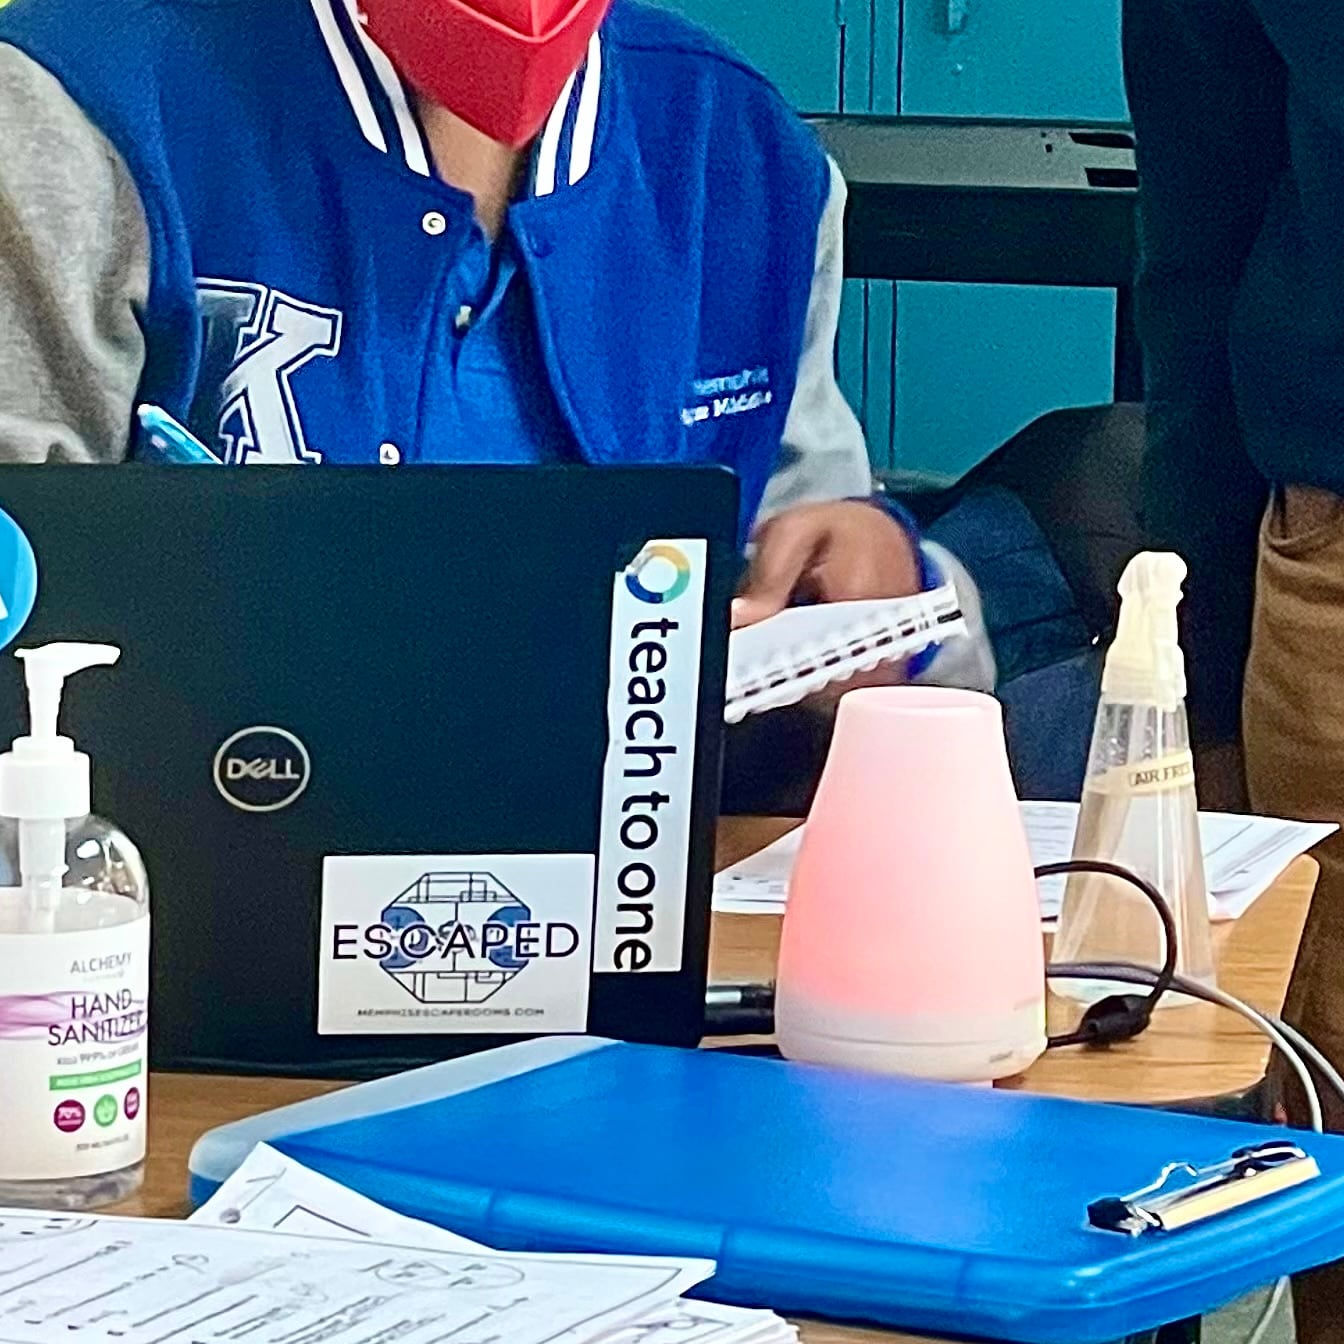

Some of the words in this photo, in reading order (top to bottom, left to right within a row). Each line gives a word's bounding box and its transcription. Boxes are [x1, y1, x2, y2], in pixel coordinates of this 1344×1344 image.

[186, 276, 343, 464] K
[624, 617, 679, 778] teach
[227, 757, 301, 780] DELL
[1135, 769, 1160, 786] AIR
[620, 791, 670, 851] to
[332, 922, 580, 960] ESCAPED
[613, 862, 656, 971] one
[71, 988, 133, 1019] HAND
